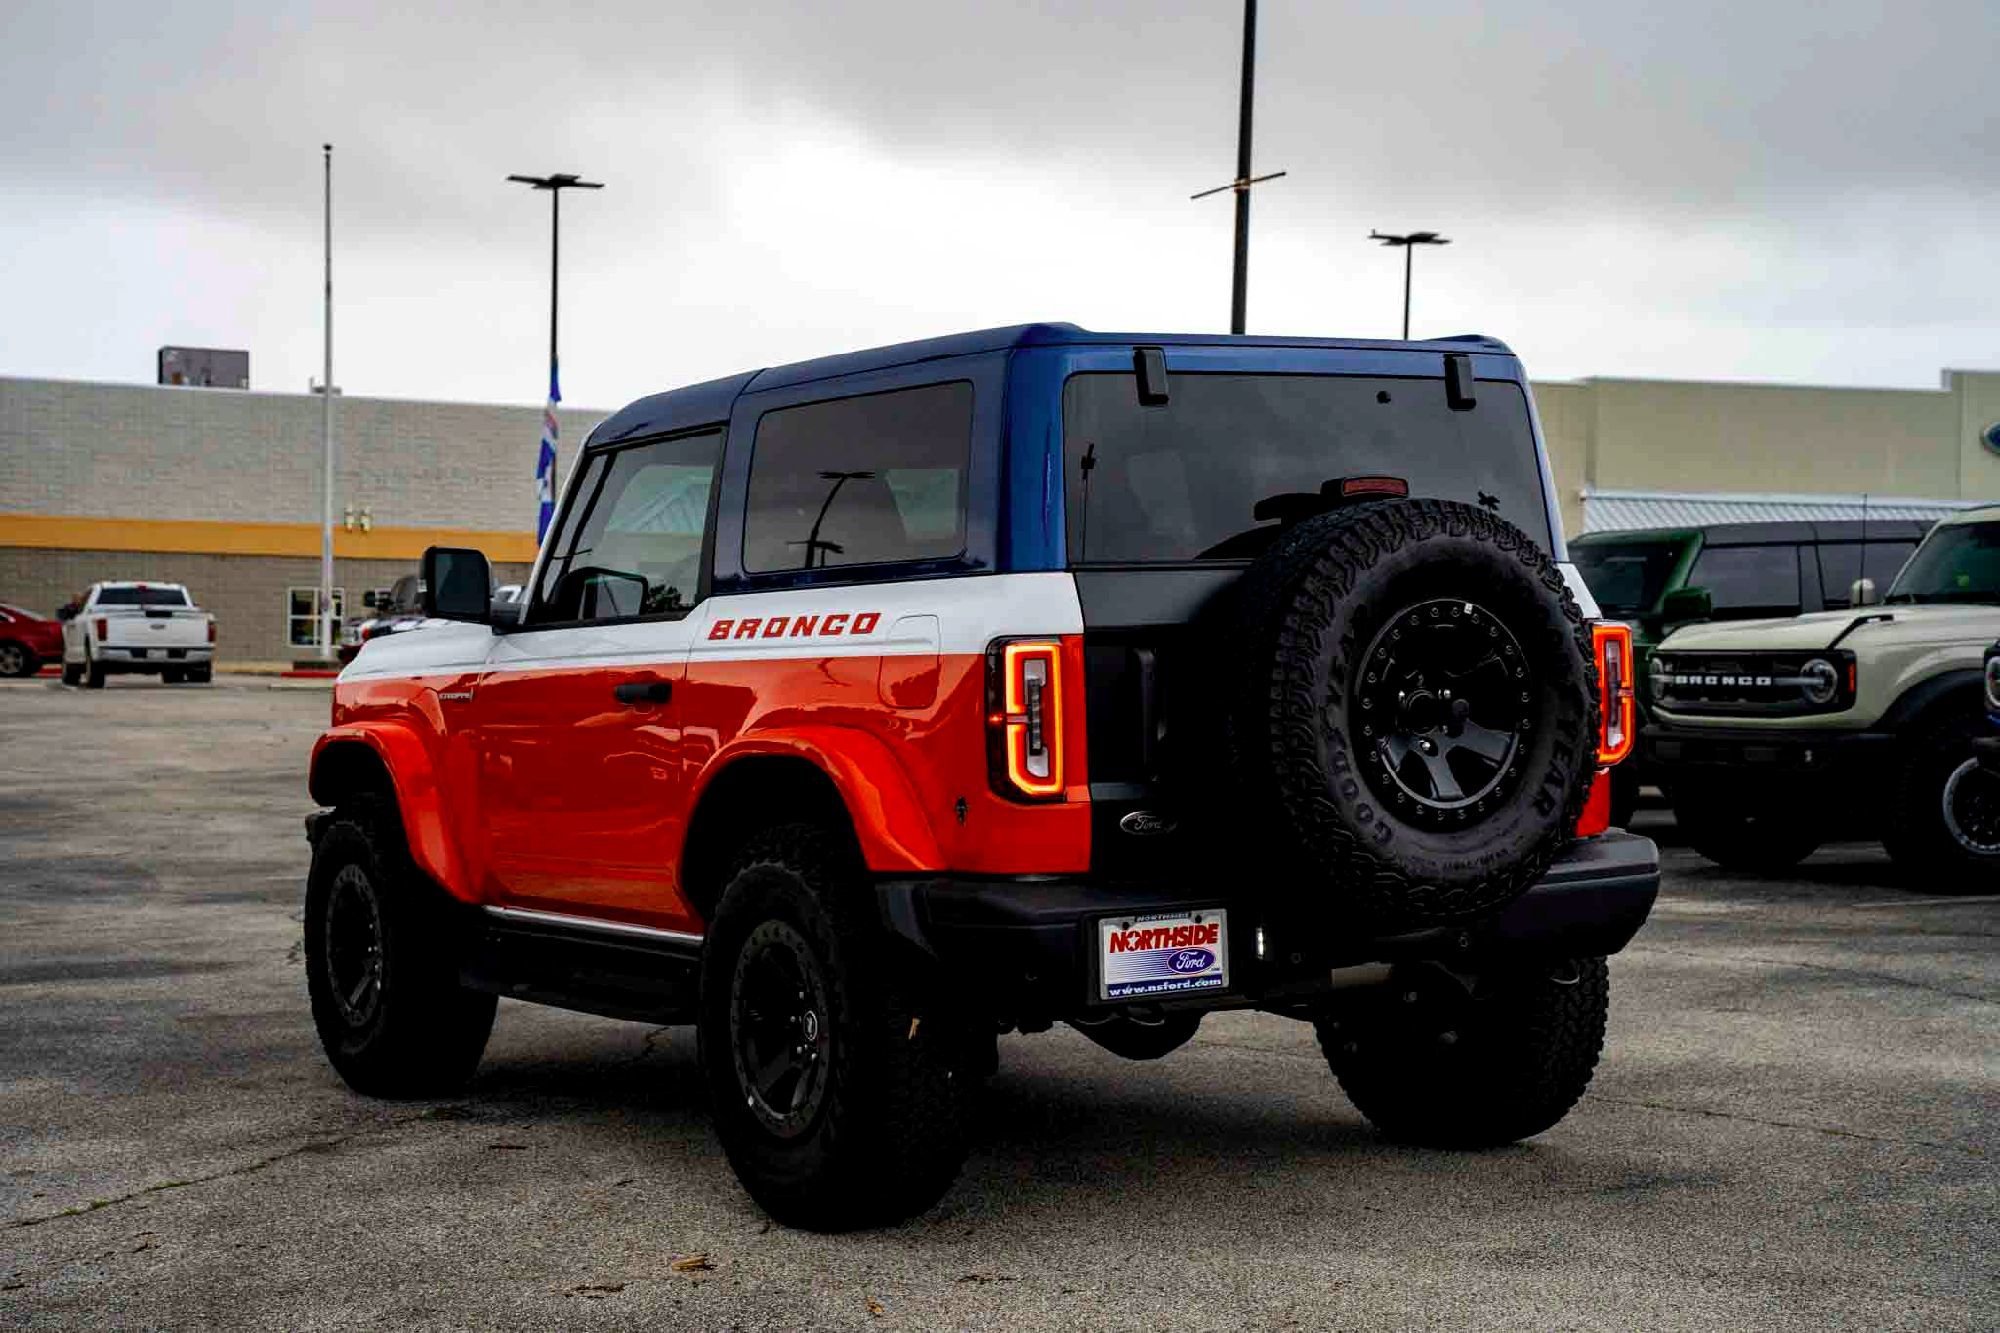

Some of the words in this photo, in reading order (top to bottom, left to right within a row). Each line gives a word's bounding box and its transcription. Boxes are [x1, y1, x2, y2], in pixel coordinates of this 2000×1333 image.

[708, 613, 881, 640] BRONCO
[1675, 675, 1772, 686] BRONCO
[1109, 923, 1219, 953] NORTHSIDE
[1176, 951, 1205, 969] Ford
[1109, 977, 1222, 996] www.nsford.com
